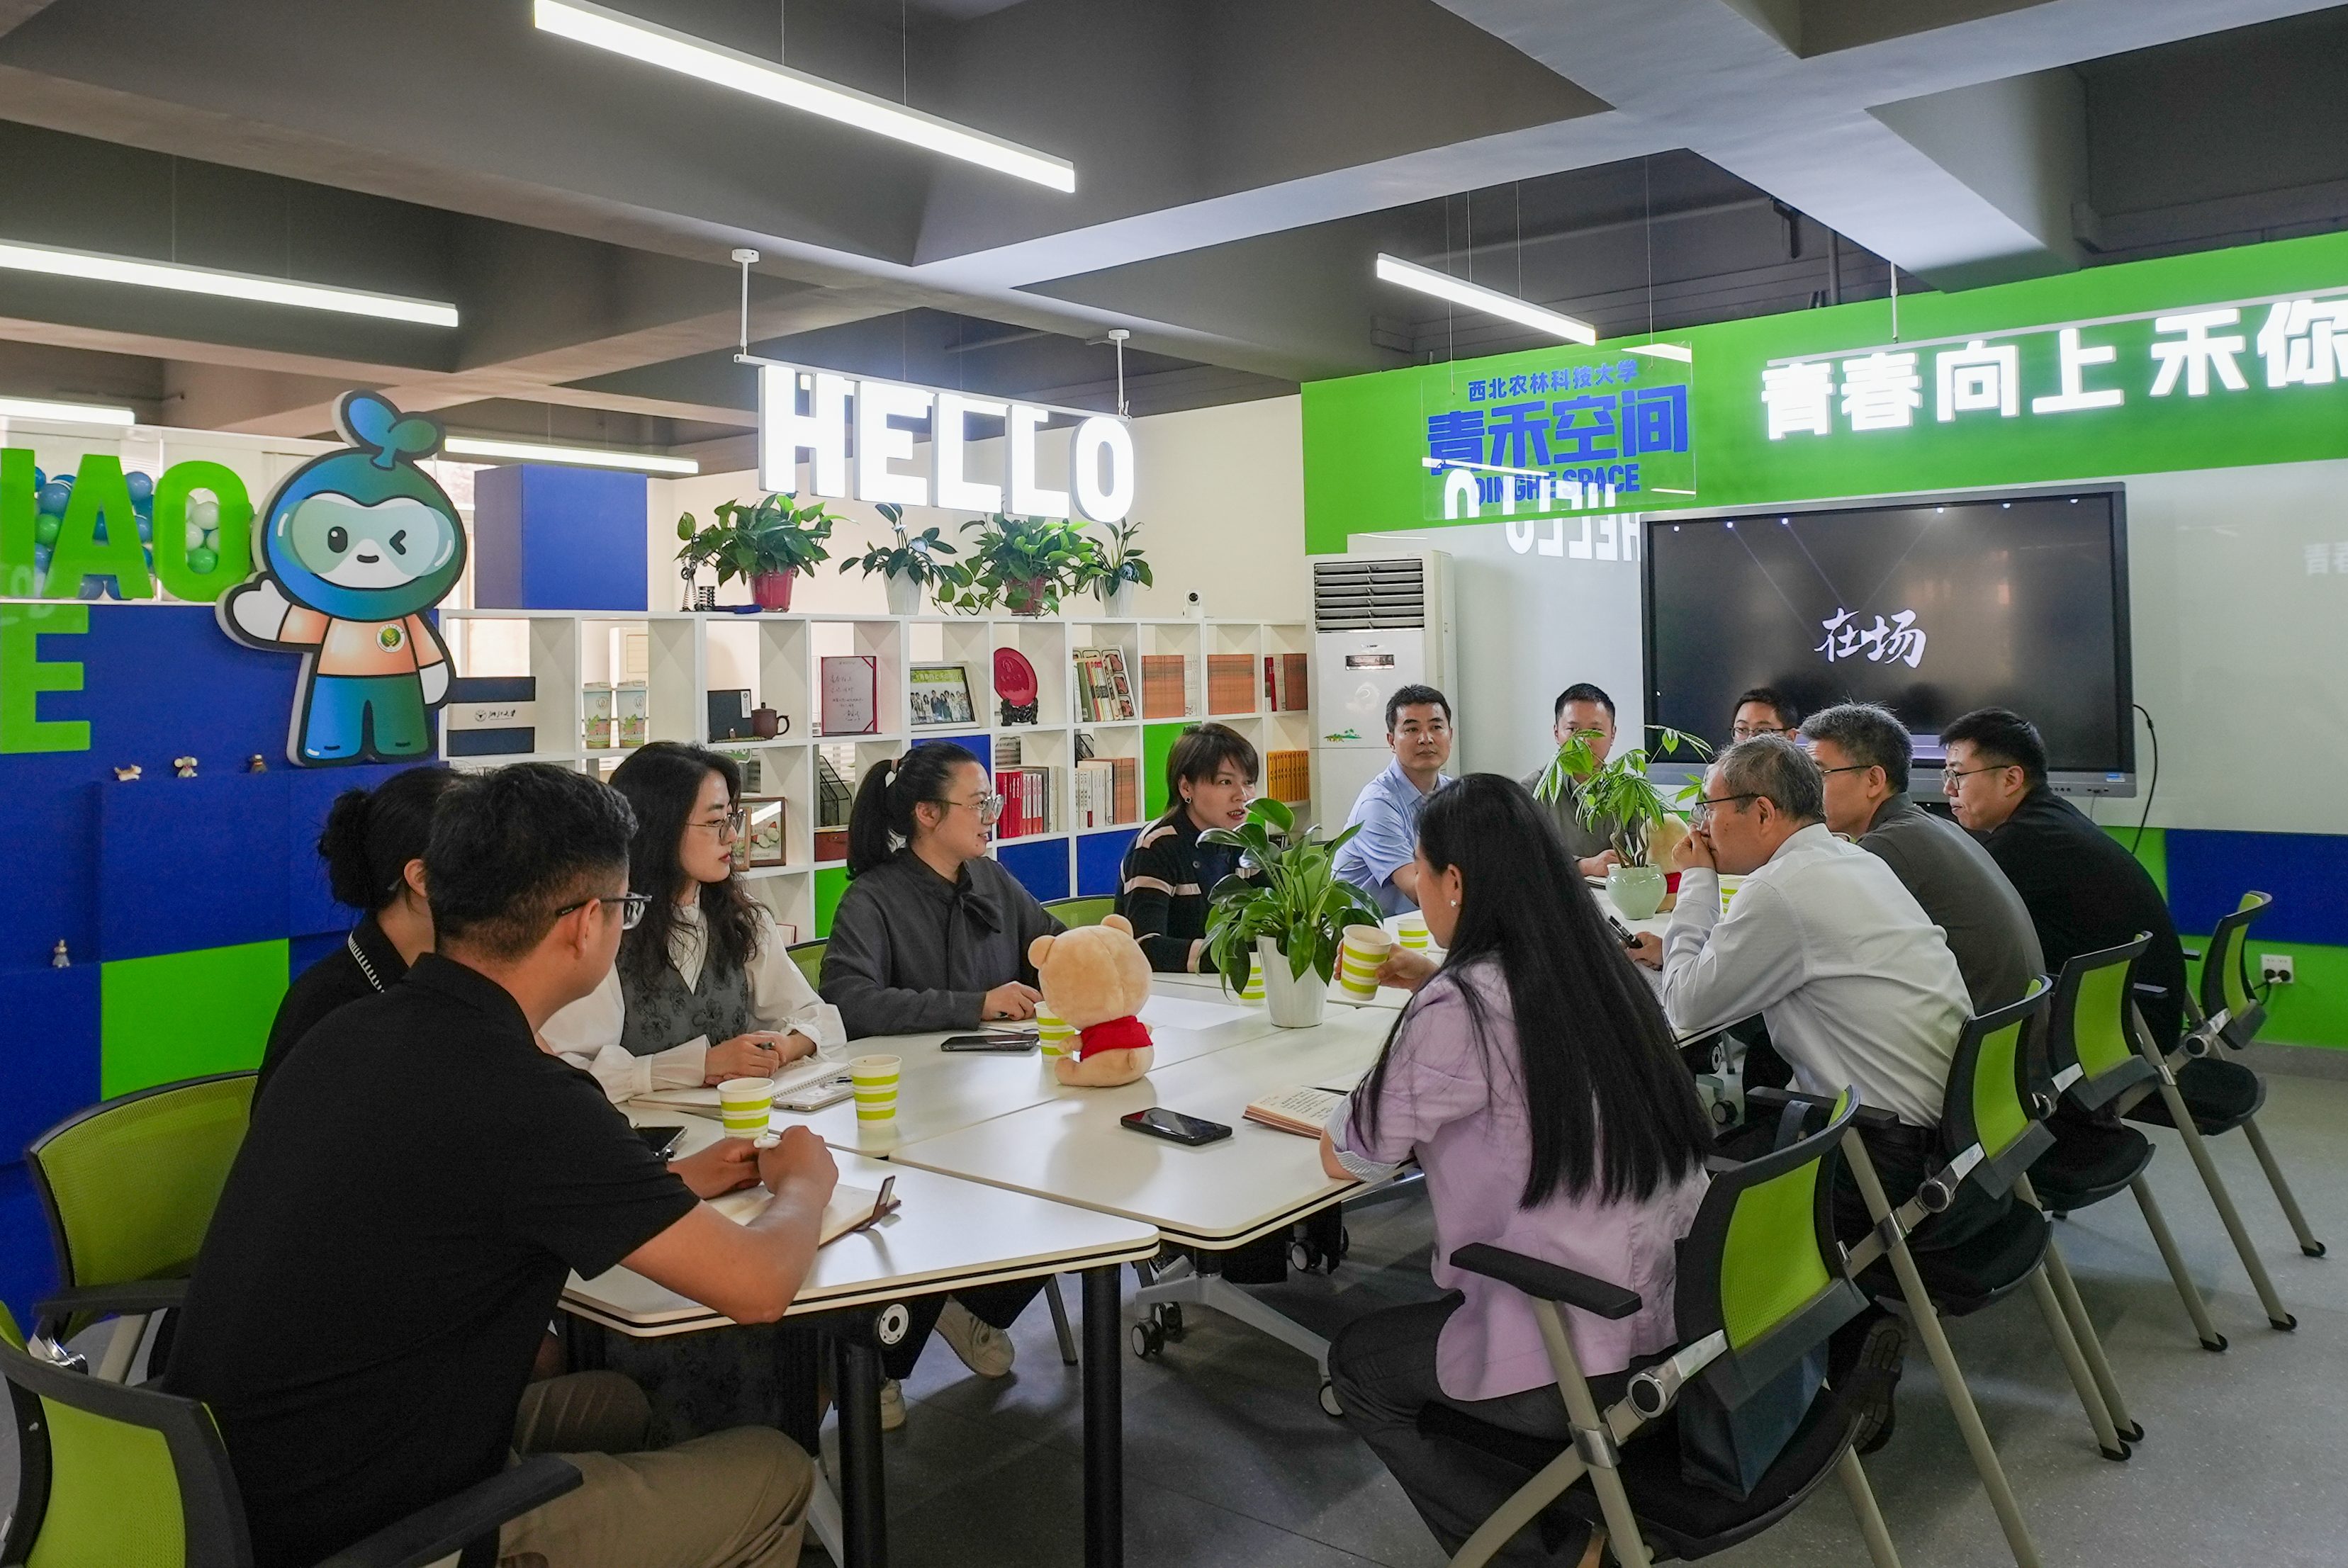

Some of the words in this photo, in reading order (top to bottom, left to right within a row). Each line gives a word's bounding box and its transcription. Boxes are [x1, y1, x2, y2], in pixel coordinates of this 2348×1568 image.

[1468, 359, 1639, 402] 西北农林科技大学
[1760, 328, 2124, 441] 青春向上
[758, 364, 1134, 523] HELLO
[1427, 385, 1689, 476] 青禾空间
[1562, 463, 1640, 498] SPACE
[1813, 607, 1927, 669] 在场
